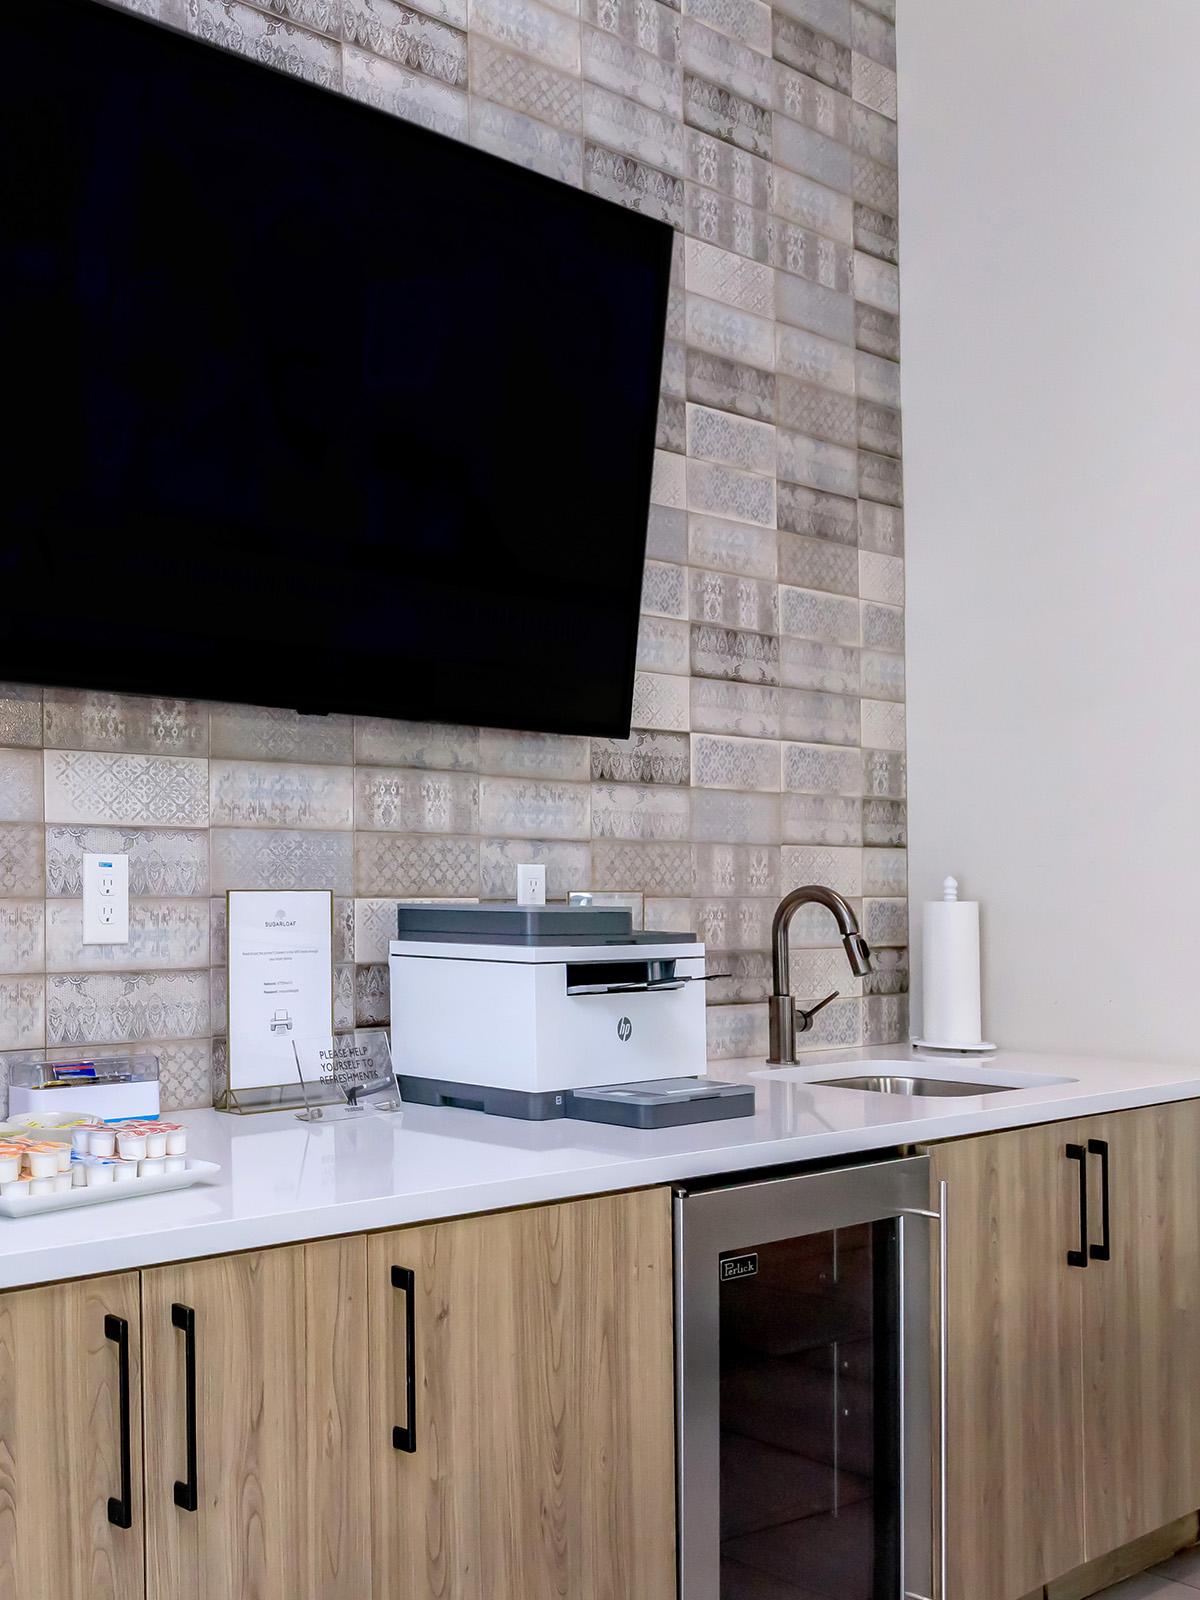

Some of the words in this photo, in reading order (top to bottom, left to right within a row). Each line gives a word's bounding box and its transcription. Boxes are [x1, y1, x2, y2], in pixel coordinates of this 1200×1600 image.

[319, 1048, 348, 1060] PLEASE
[348, 1046, 368, 1057] HELP
[320, 1060, 360, 1073] YOURSELF
[362, 1058, 374, 1068] TO
[319, 1069, 379, 1085] REFRESHMENTS
[724, 1260, 755, 1277] Perlick
